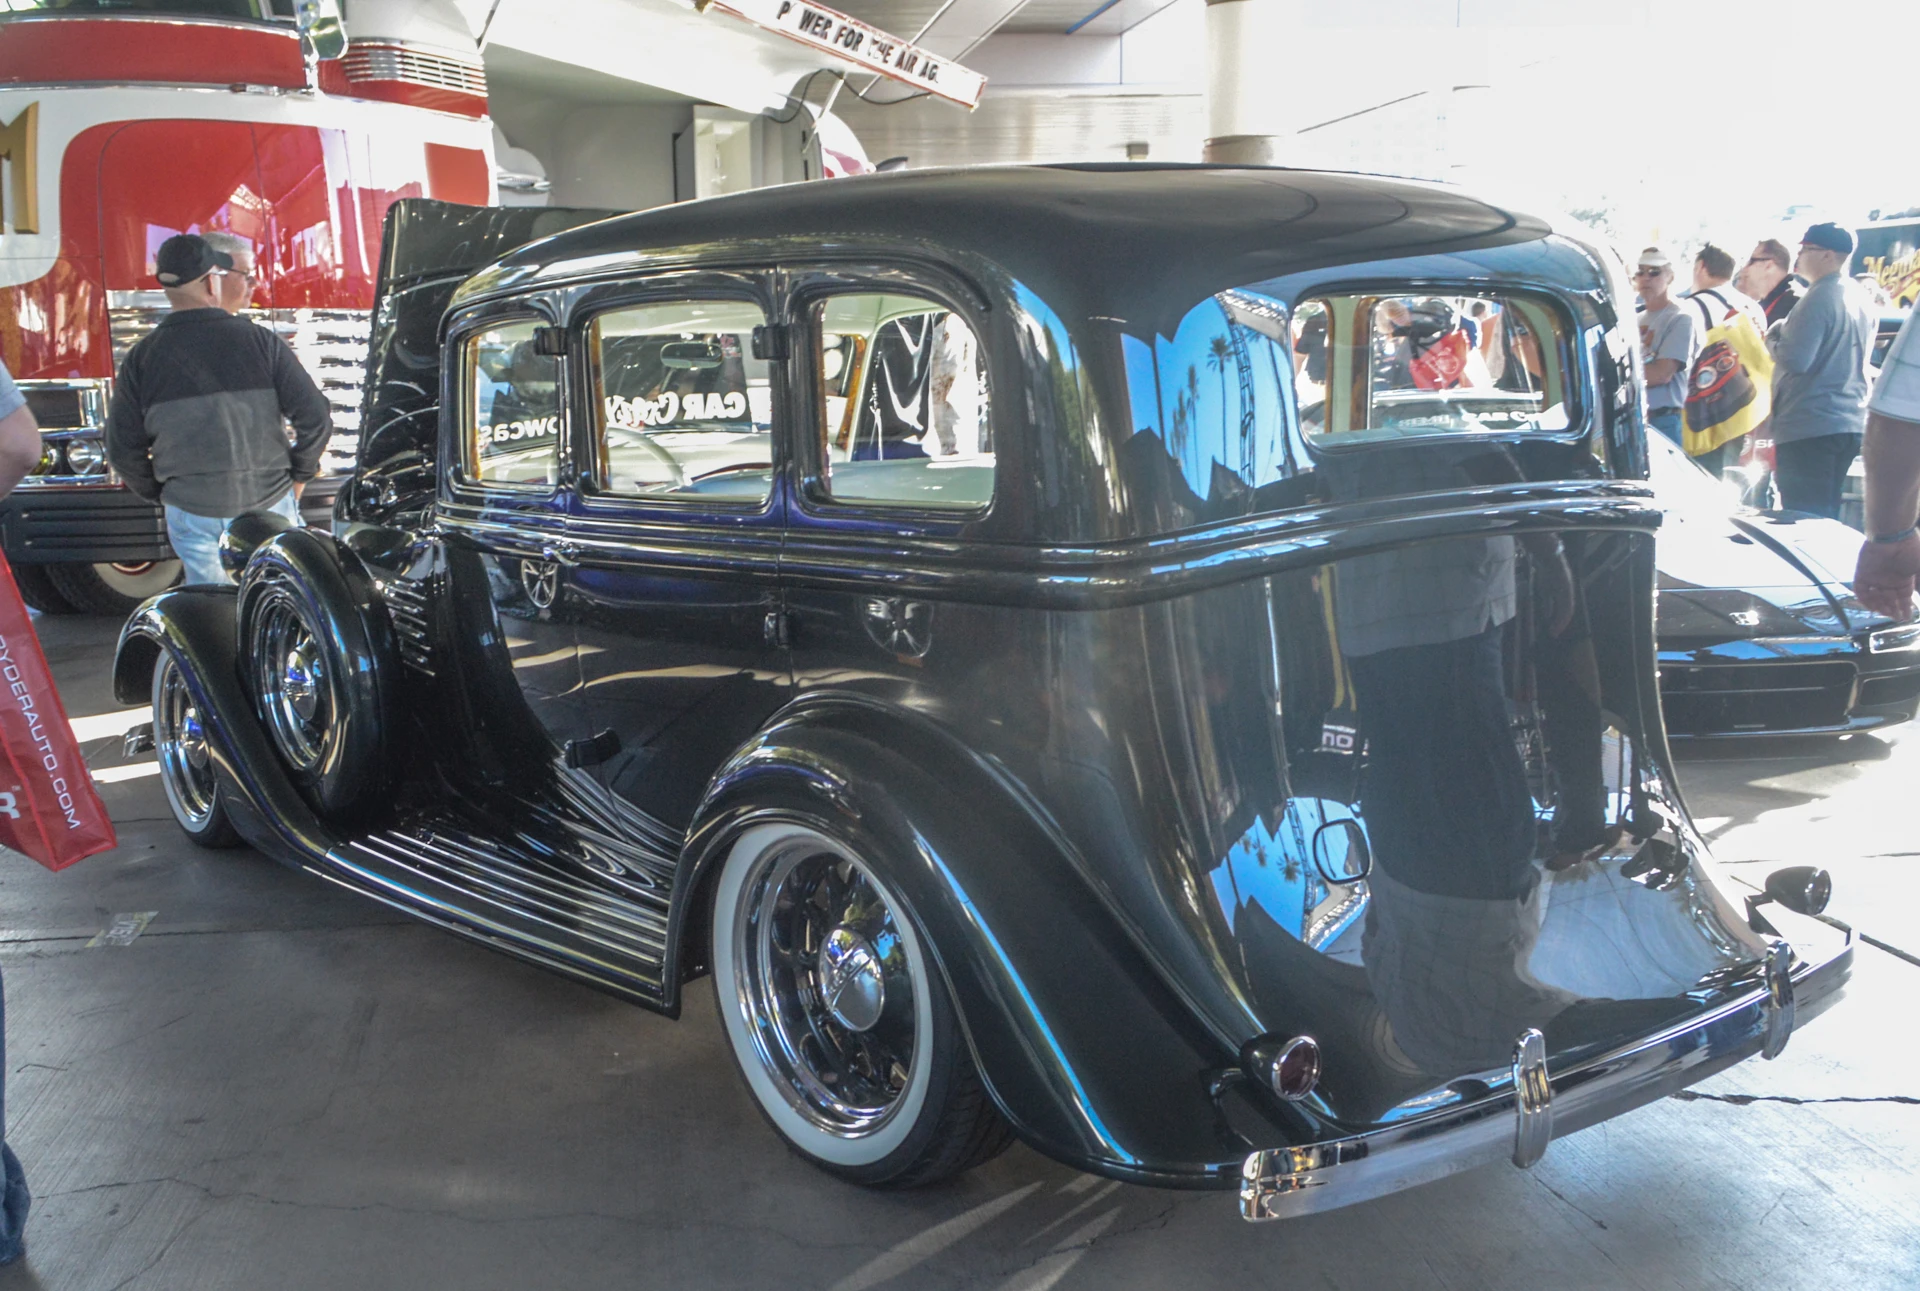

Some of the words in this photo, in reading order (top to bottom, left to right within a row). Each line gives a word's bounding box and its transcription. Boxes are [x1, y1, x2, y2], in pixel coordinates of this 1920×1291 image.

[776, 0, 833, 40] PWER
[832, 25, 864, 52] FOR
[895, 50, 918, 75] AIR
[919, 61, 940, 84] AG
